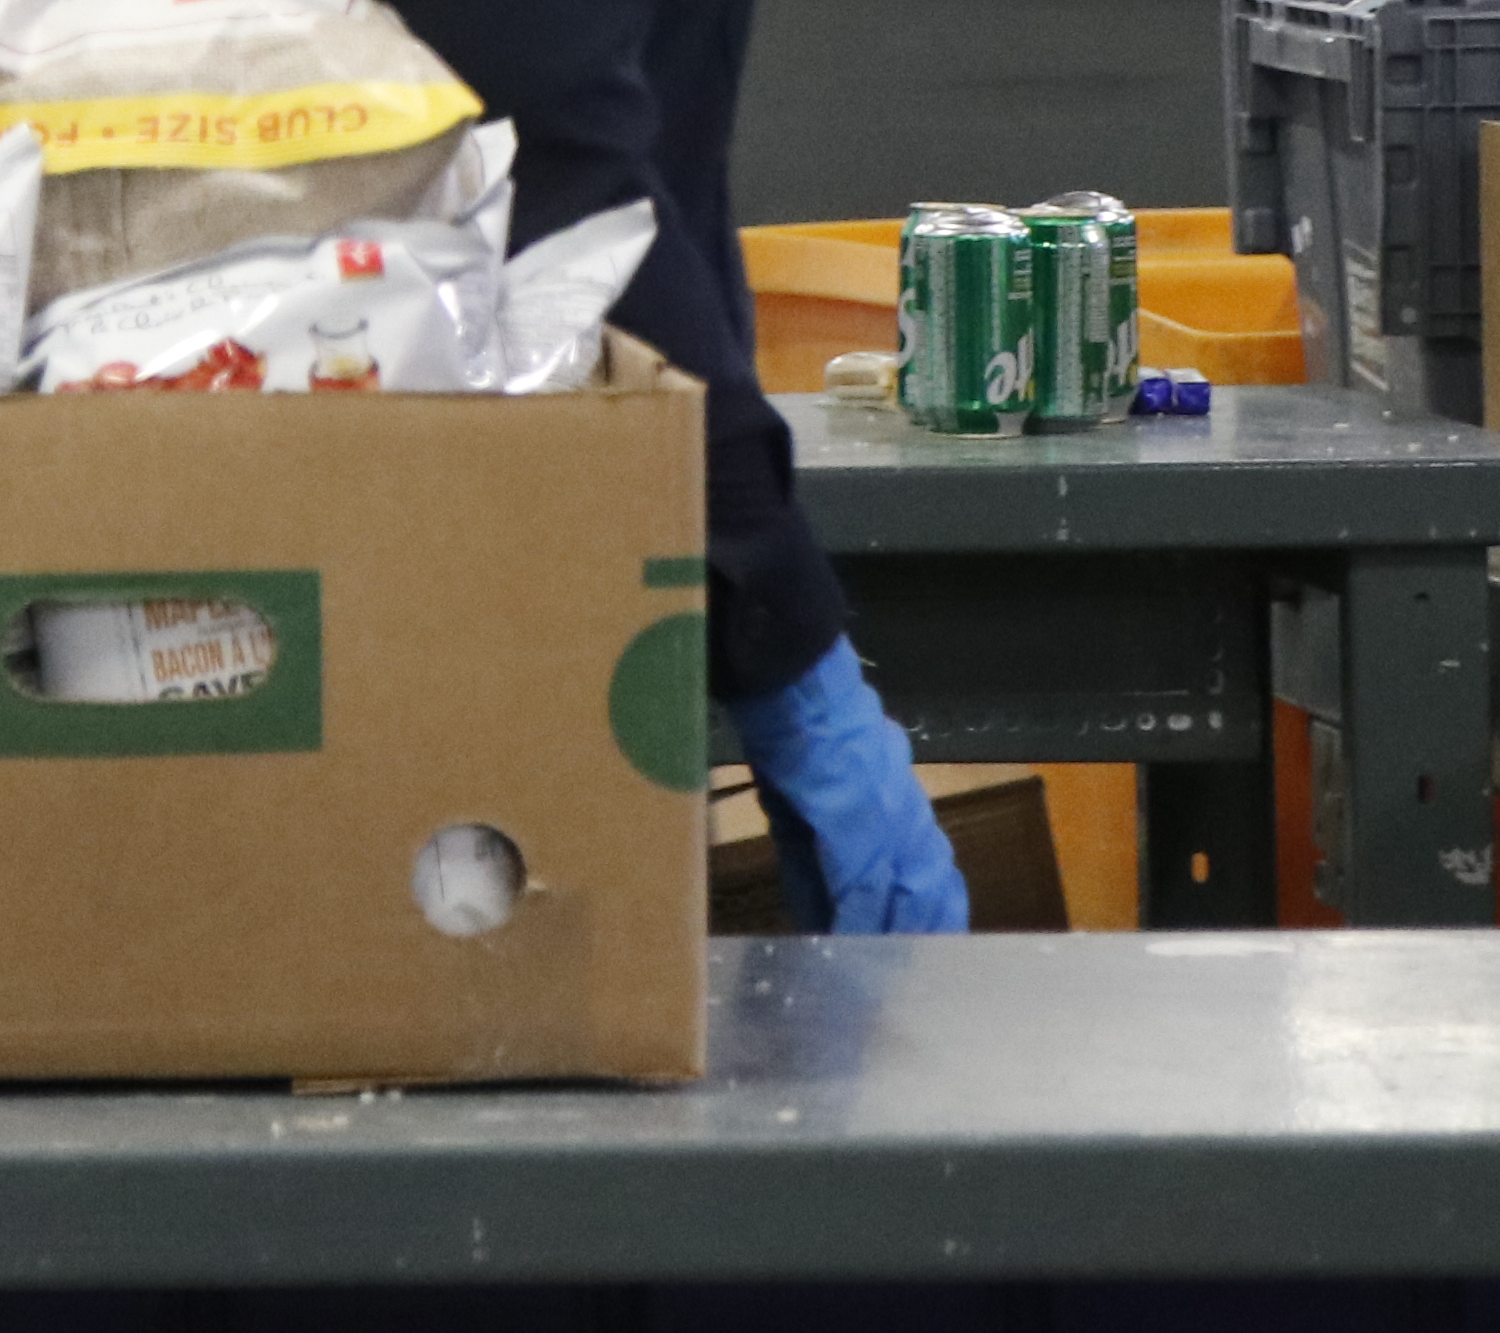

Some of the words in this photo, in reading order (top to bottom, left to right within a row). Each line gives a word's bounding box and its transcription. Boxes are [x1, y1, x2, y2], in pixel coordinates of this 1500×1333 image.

[135, 113, 238, 146] SIZE
[256, 103, 369, 146] CLUB
[152, 638, 225, 683] BACON
